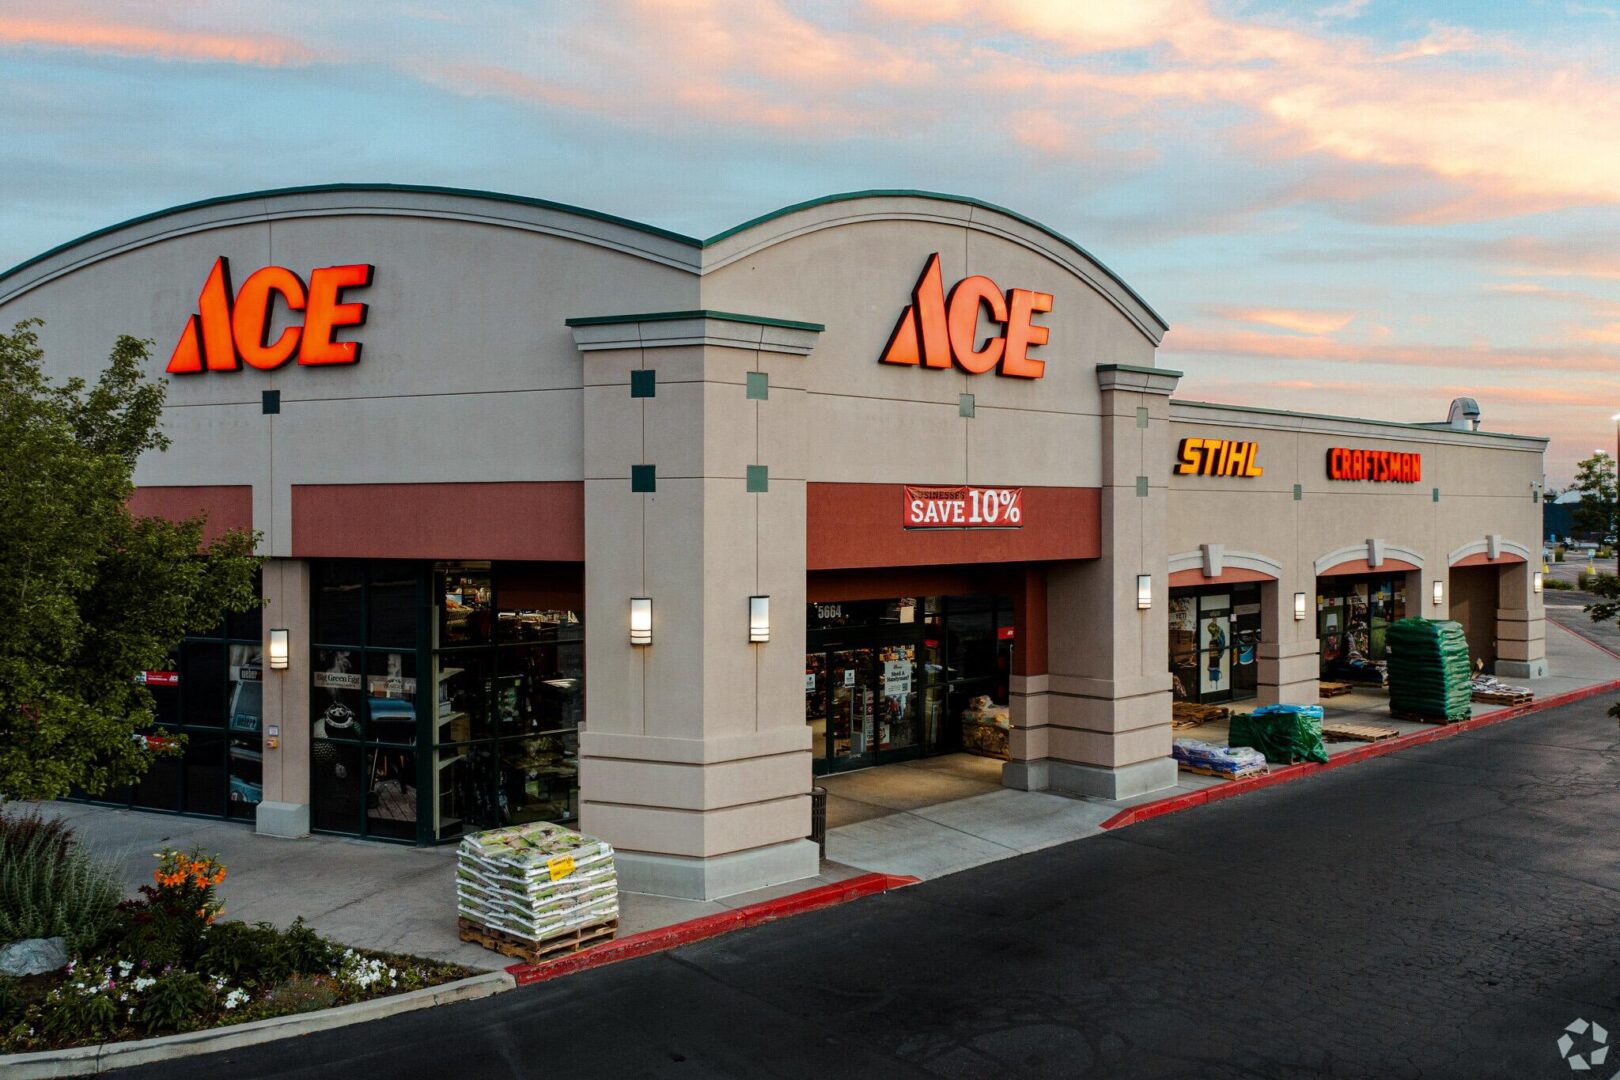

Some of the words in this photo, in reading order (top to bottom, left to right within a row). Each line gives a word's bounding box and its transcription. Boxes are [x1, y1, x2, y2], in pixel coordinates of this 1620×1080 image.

[166, 256, 374, 374] ACE
[879, 252, 1054, 378] ACE
[1175, 437, 1264, 477] STIHL
[1328, 447, 1421, 482] CRAFTSMAN
[911, 499, 965, 523] SAVE
[968, 489, 1020, 523] 10%
[818, 605, 842, 619] 5664
[328, 674, 347, 682] Green
[348, 675, 360, 684] Egg
